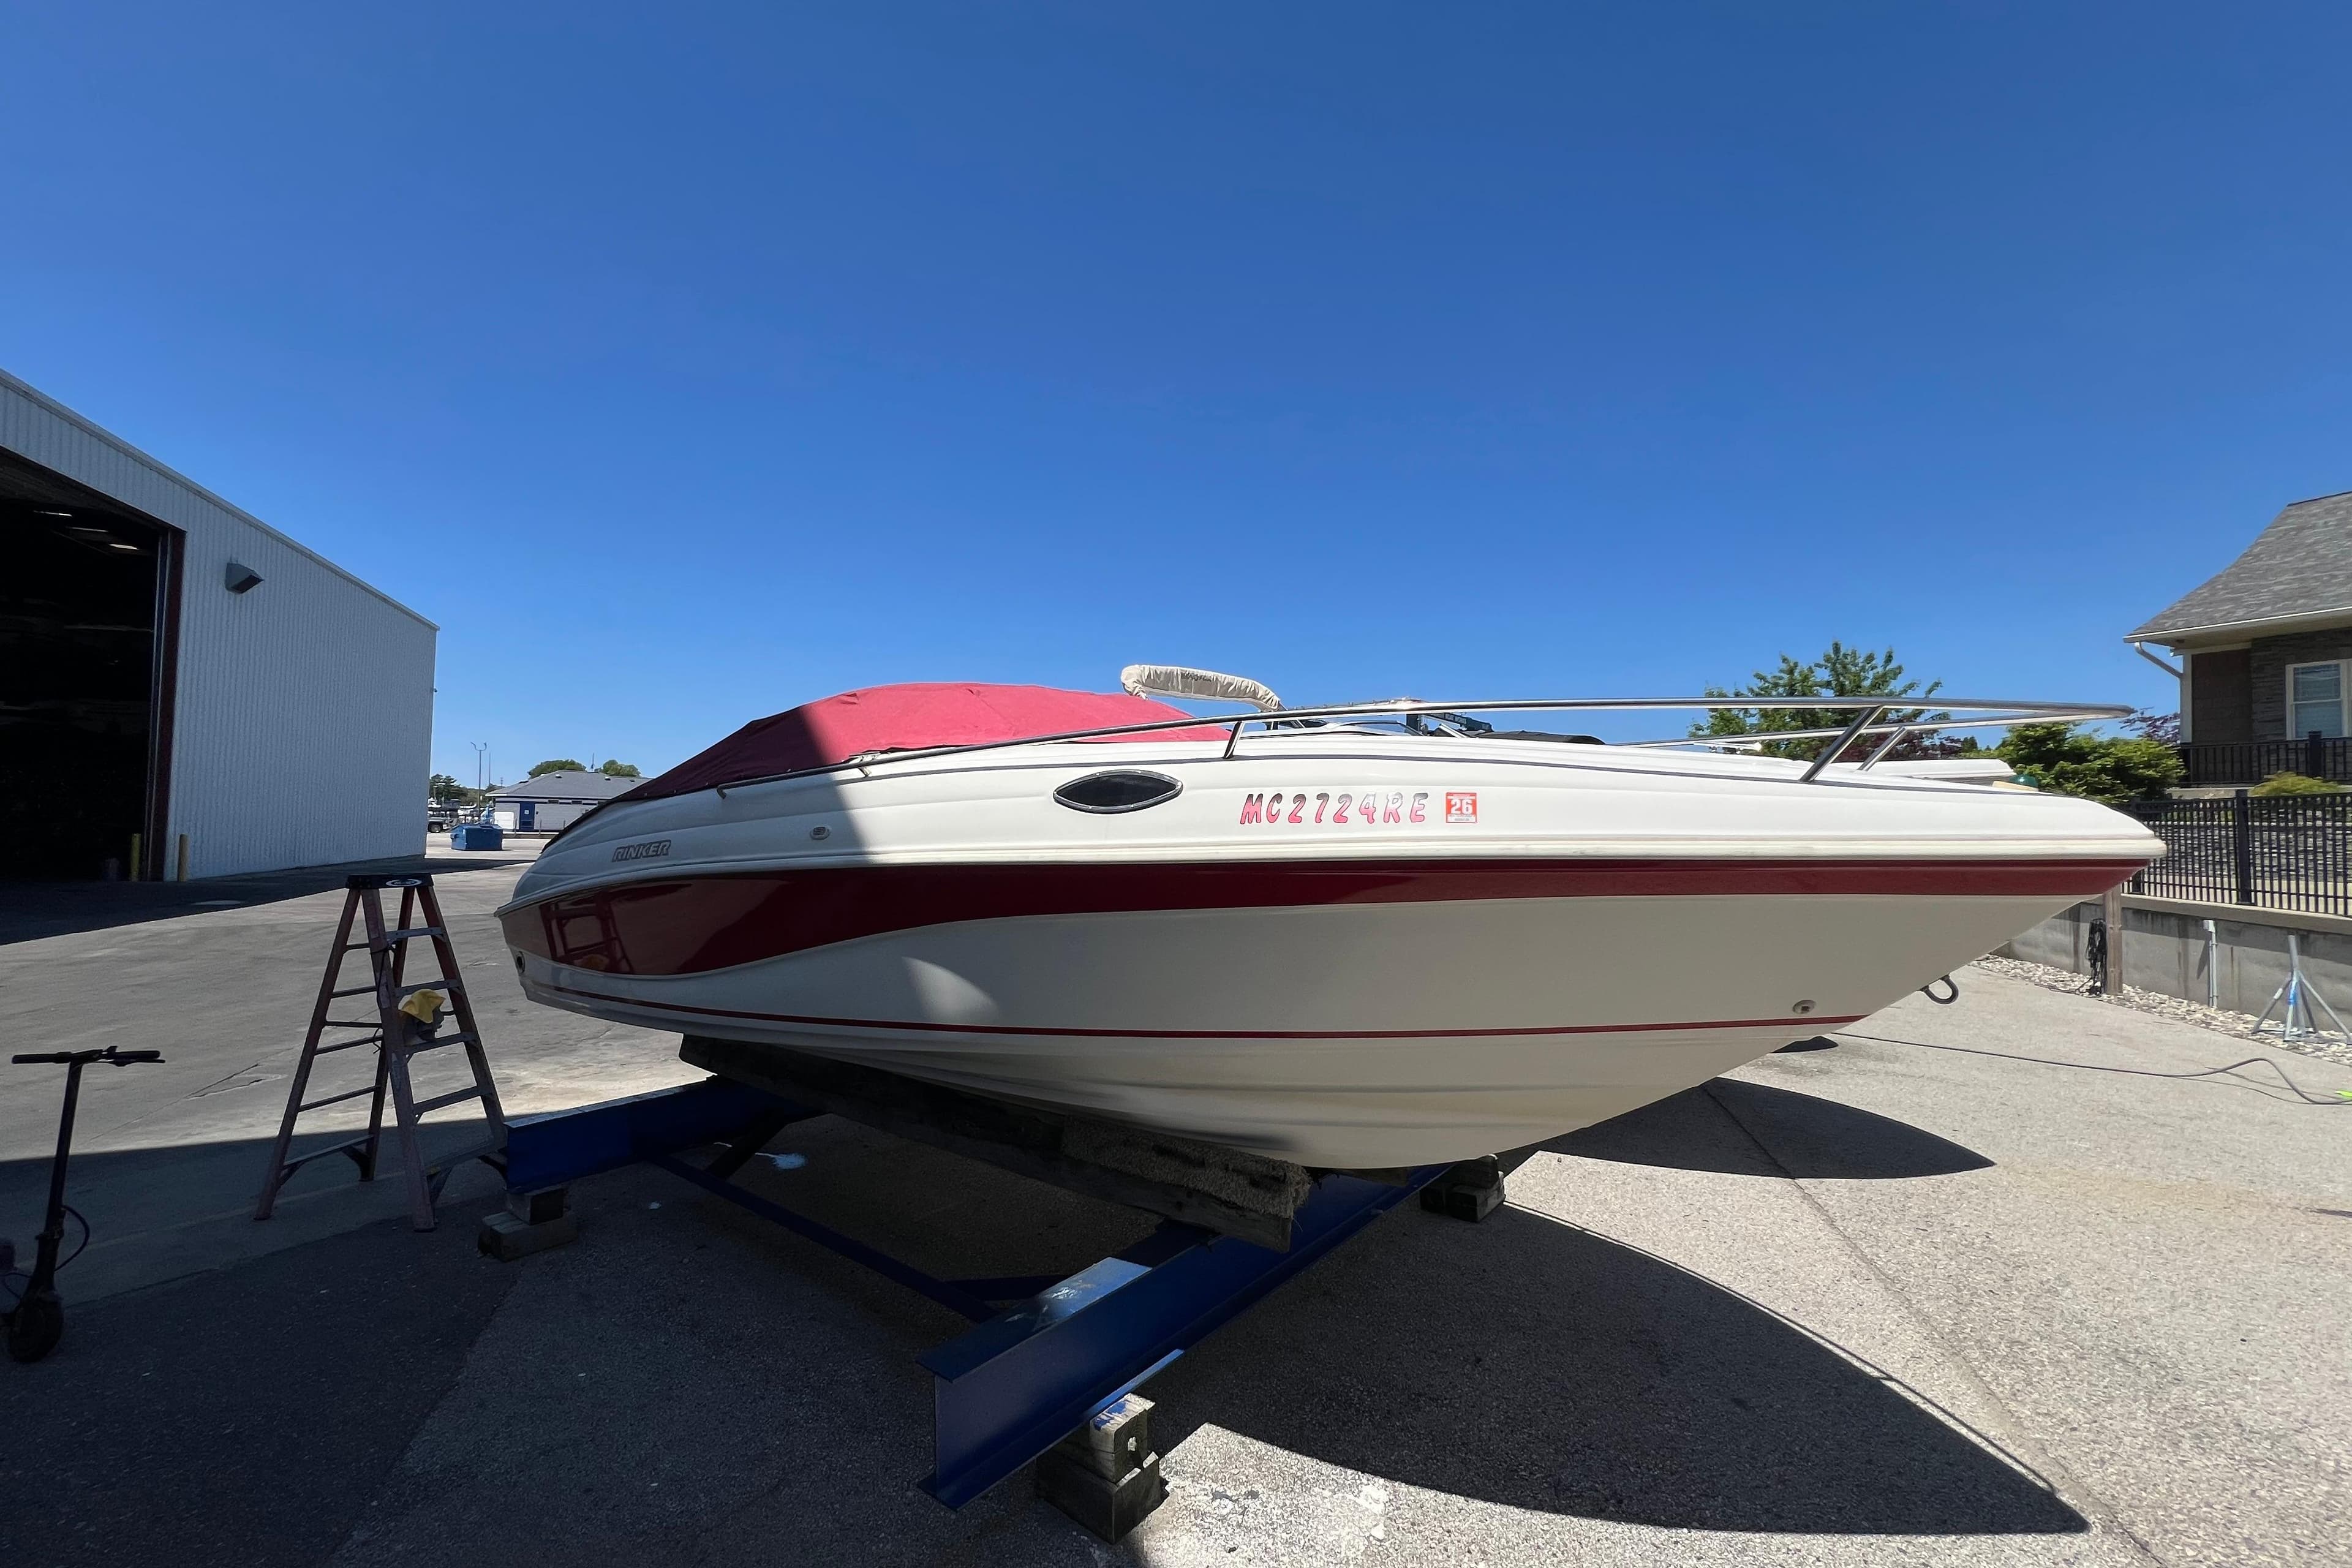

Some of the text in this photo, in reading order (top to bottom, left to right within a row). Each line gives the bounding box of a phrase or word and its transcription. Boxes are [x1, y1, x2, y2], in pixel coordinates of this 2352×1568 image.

[1240, 793, 1428, 824] MC2724RE
[1450, 799, 1473, 814] 26
[612, 839, 671, 862] RINKER
